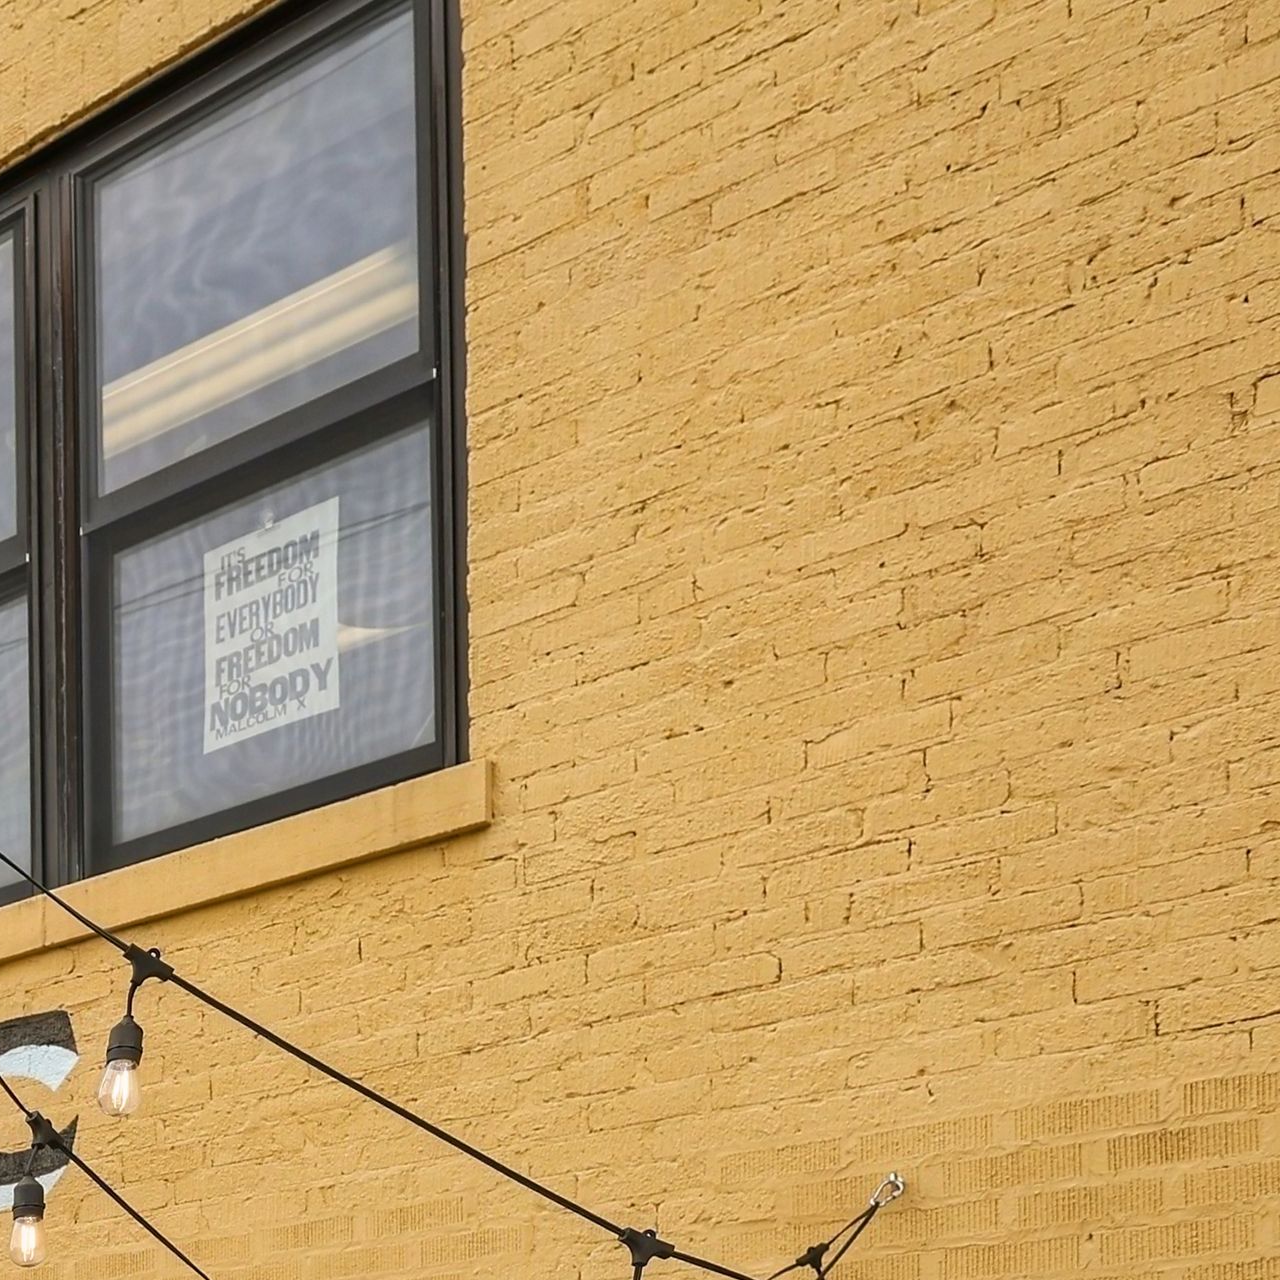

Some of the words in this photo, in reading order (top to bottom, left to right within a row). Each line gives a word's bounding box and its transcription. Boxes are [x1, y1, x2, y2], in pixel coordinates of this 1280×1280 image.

[214, 529, 320, 602] FREEDOM
[220, 546, 245, 571] IT'S
[277, 560, 314, 588] FOR
[215, 572, 320, 644] EVERYBODY
[215, 617, 320, 688] FREEDOM
[250, 621, 275, 643] OR
[209, 657, 334, 732] NOBODY
[218, 674, 251, 700] FOR
[215, 703, 288, 741] MALCOLM
[296, 696, 307, 711] X
